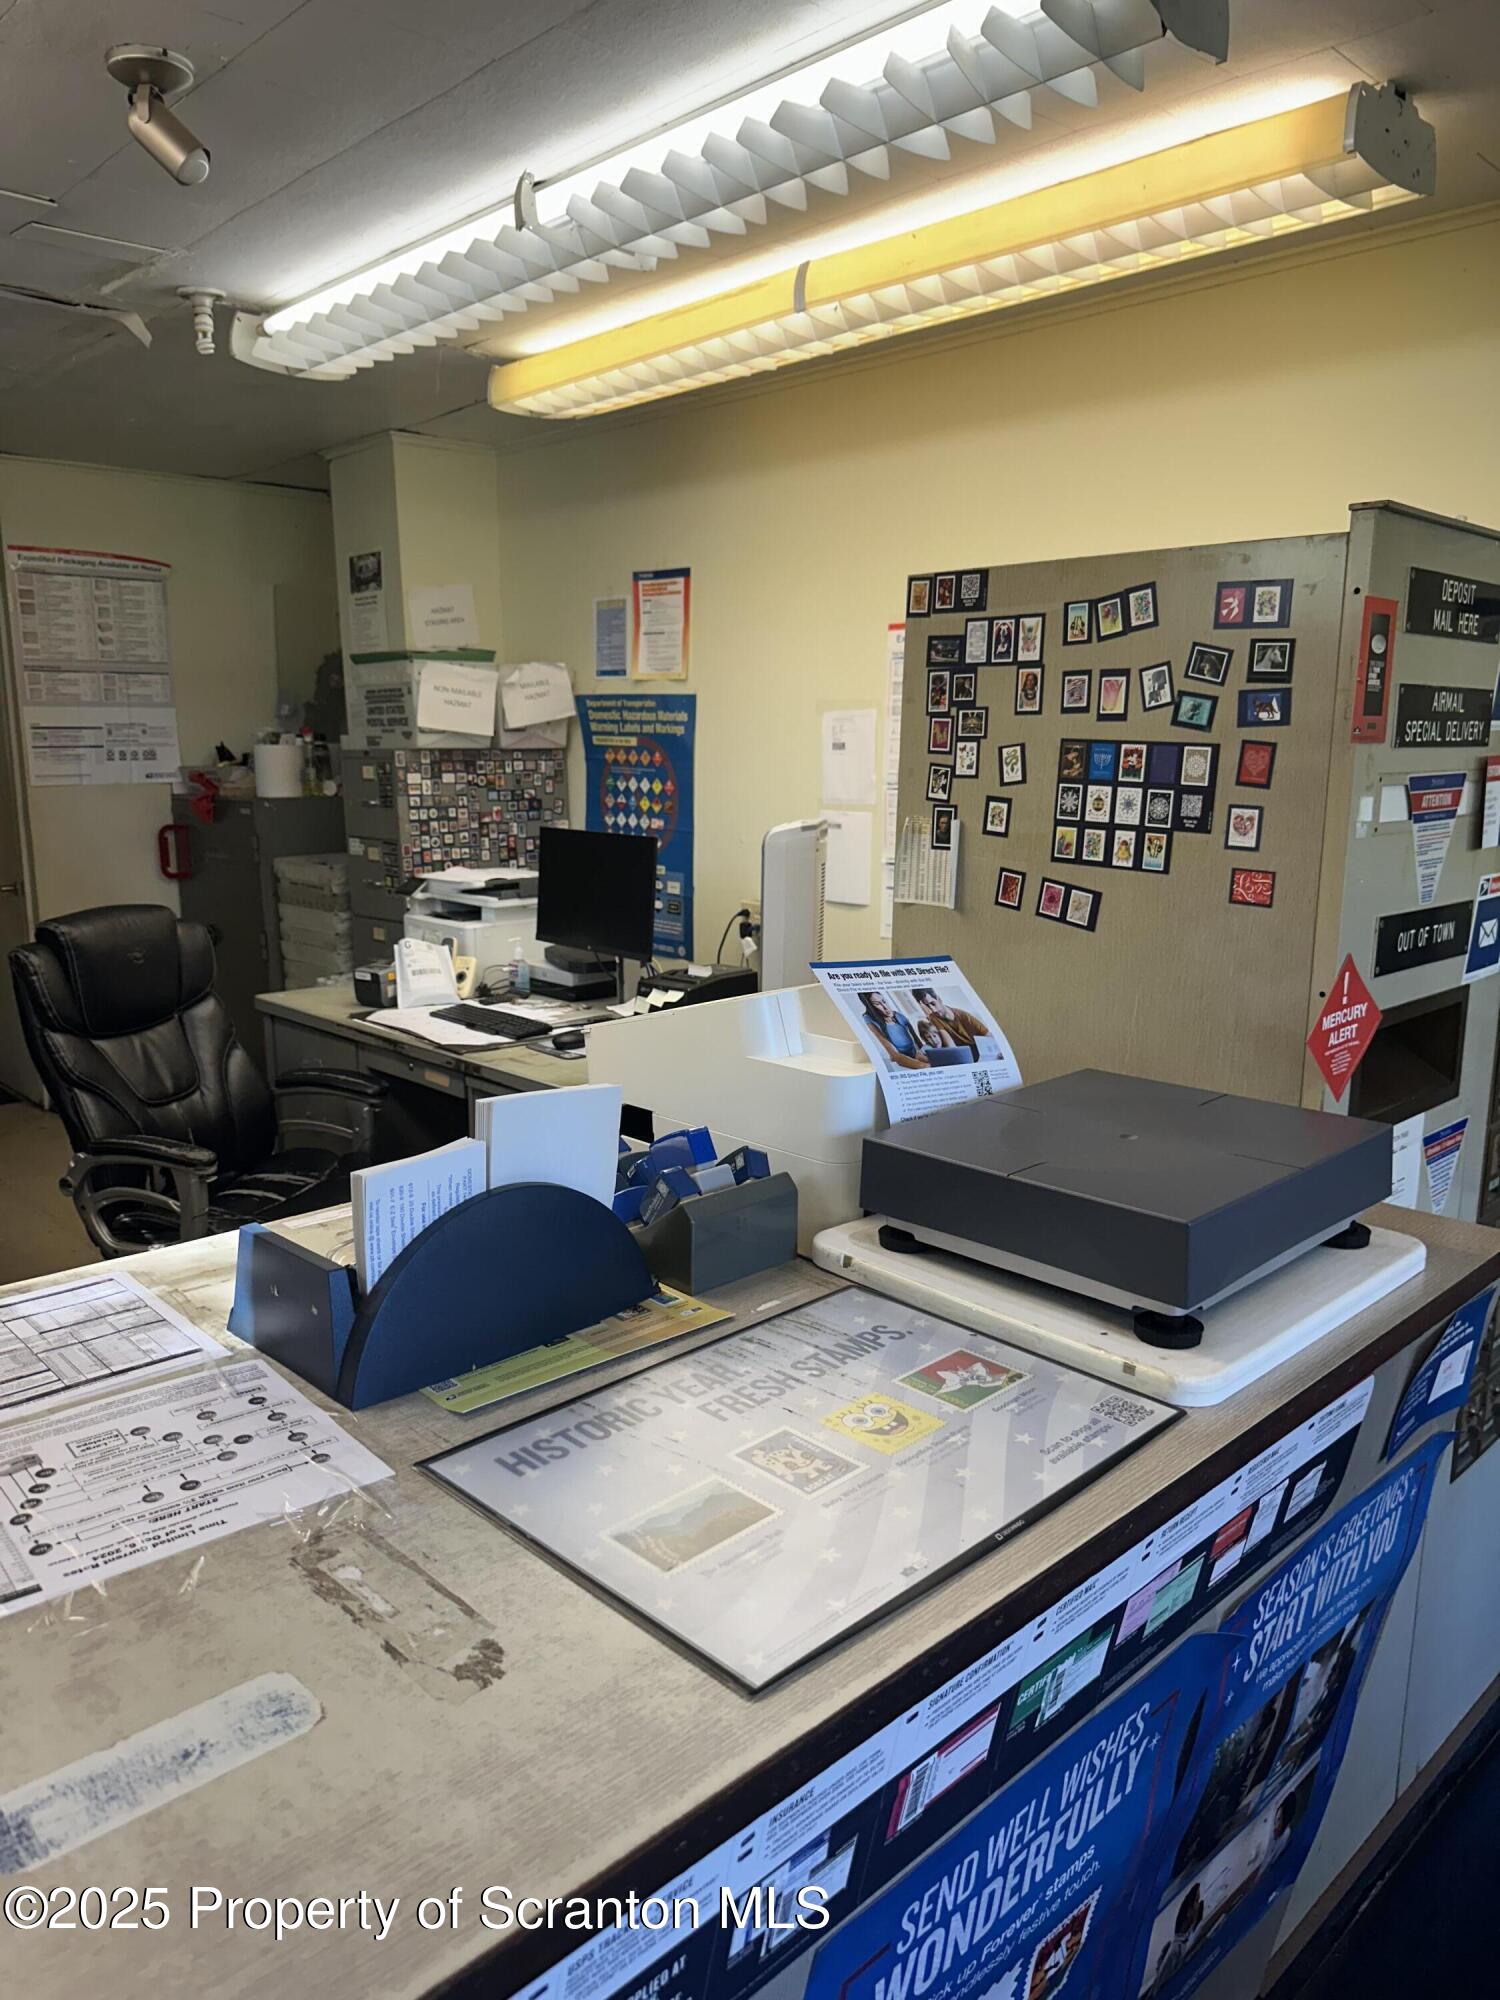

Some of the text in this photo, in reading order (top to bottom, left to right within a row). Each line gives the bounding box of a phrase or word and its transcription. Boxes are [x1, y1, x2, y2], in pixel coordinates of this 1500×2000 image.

[1441, 579, 1476, 605] DEPOSIT
[1433, 609, 1480, 636] MAIL HERE
[1431, 691, 1465, 713] AIRMAIL
[588, 710, 688, 722] Domestic Hazardous Materials
[590, 722, 685, 736] Warning Labels and Markings
[1405, 720, 1485, 742] SPECIAL DELIVERY
[1397, 920, 1456, 953] OUT OF TOWN
[827, 965, 950, 981] Are you ready to file with IRS Direct File?
[1321, 1002, 1368, 1031] MERCURY
[1327, 1023, 1358, 1047] ALERT
[697, 1324, 914, 1423] FRESH STAMPS.
[494, 1392, 663, 1478] HISTORIC
[659, 1363, 752, 1412] YEAR.
[76, 1434, 119, 1448] Envelope
[80, 1442, 108, 1453] Large
[149, 1497, 218, 1523] START HERE:
[165, 1529, 176, 1537] of
[179, 1523, 193, 1531] as
[198, 1519, 227, 1531] Time
[151, 1530, 196, 1548] Limited
[1253, 1534, 1336, 1630] SEASON'S
[1335, 1467, 1415, 1558] GREETINGS
[92, 1548, 121, 1561] 2024
[1056, 1589, 1084, 1617] CERTIFIED
[1243, 1583, 1315, 1684] START
[1312, 1542, 1366, 1620] WITH
[1364, 1505, 1402, 1572] YOU
[928, 1644, 1012, 1711] SIGNATURE CONFIRMATION
[769, 1786, 816, 1827] INSURANCE
[897, 1850, 980, 1954] SEND
[986, 1787, 1054, 1878] WELL
[1060, 1702, 1150, 1812] WISHES
[875, 1738, 1148, 2000] WONDERFULLY
[957, 1960, 977, 1984] up
[1044, 1844, 1095, 1901] stamps
[1018, 1897, 1061, 1945] festive
[567, 1947, 595, 1976] USPS
[671, 1953, 687, 1977] AT
